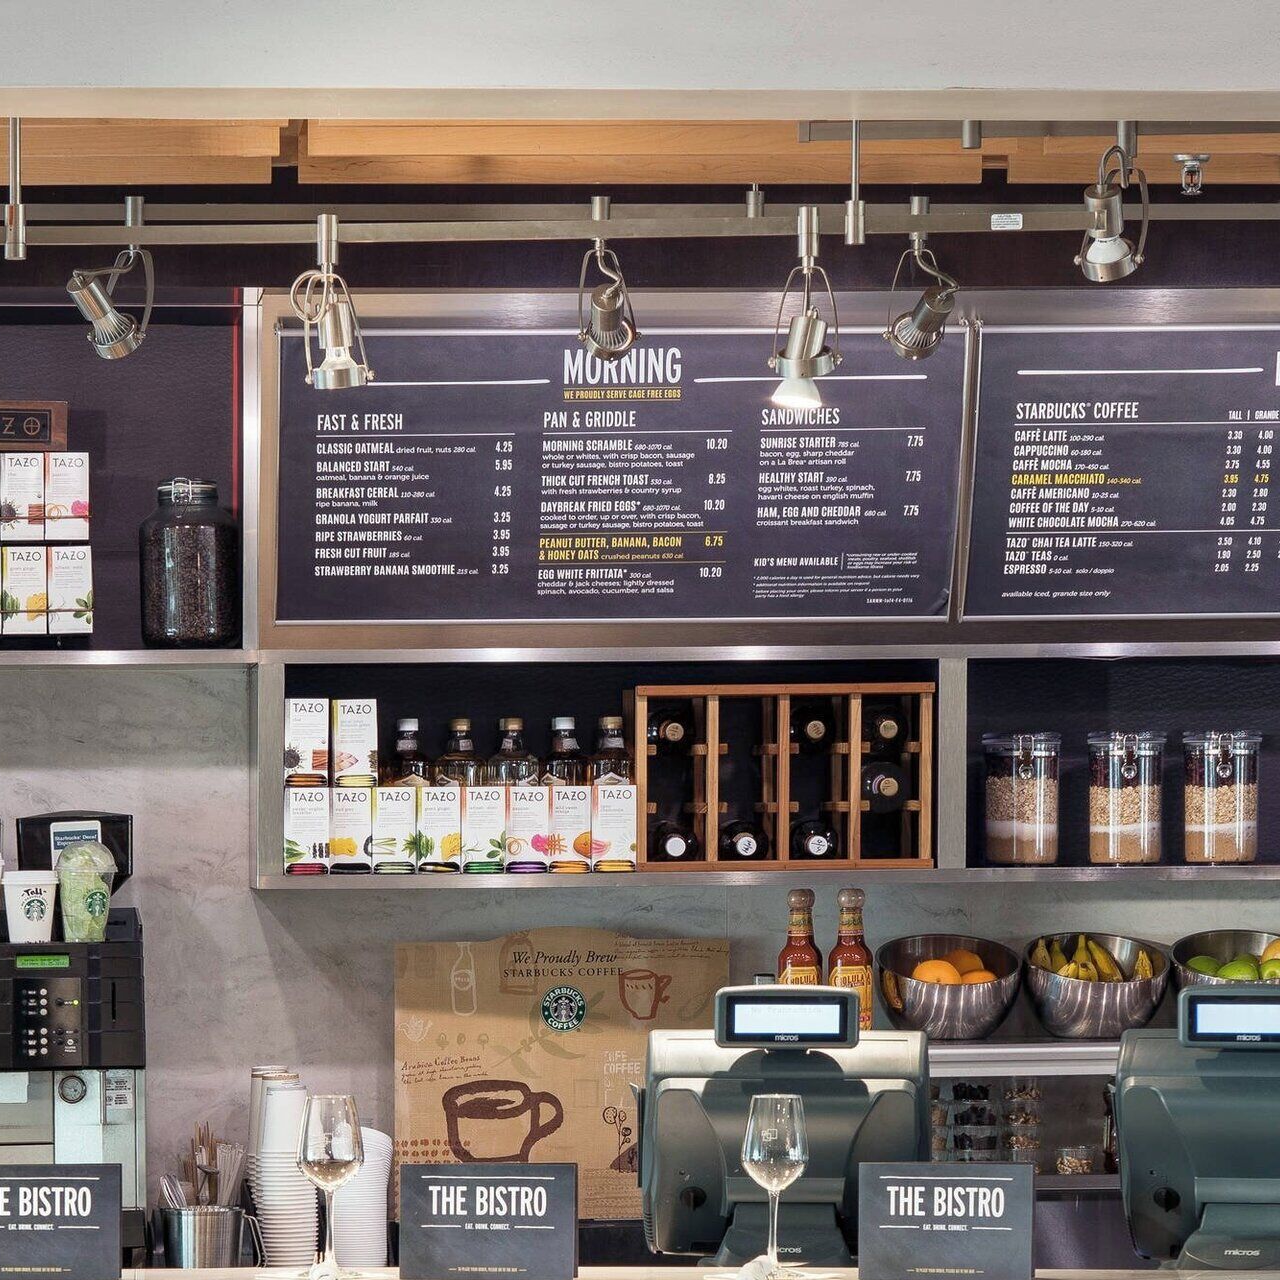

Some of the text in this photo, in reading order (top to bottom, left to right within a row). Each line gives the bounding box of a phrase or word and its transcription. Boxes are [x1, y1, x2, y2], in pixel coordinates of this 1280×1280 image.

[564, 348, 681, 384] MORNING
[564, 390, 680, 399] WE PROUDLY SERVE CAGE FREE EGGS
[1094, 402, 1139, 418] COFFEE
[1229, 411, 1242, 420] TALL
[1255, 410, 1279, 419] GRANDE
[317, 414, 403, 430] FAST & FRESH
[544, 411, 636, 428] PAN & GRIDDLE
[762, 408, 840, 425] SANDWICHES
[317, 441, 513, 454] CLASSIC OATMEAL 4.25
[761, 436, 923, 449] SUNRISE STARTER 7.75
[8, 458, 39, 467] TAZO
[1012, 474, 1052, 485] CARAMEL
[1055, 474, 1104, 484] MACCHIATO
[1224, 475, 1238, 483] 3.95
[1254, 474, 1269, 483] 4.75
[10, 552, 41, 561] TAZO
[754, 558, 774, 567] KID'S
[776, 557, 797, 566] MENU
[800, 557, 838, 566] AVAILABLE
[293, 703, 324, 713] TAZO
[340, 704, 371, 714] TAZO
[336, 793, 367, 802] TAZO
[425, 792, 456, 801] TAZO
[513, 792, 544, 801] TAZO
[601, 790, 632, 799] TAZO
[513, 950, 618, 966] We Proudly Brew
[504, 968, 624, 977] STARBUCKS COFFEE
[543, 987, 584, 1007] STARBUCKS
[547, 1018, 579, 1030] COFFEE
[19, 1187, 91, 1217] BISTRO
[429, 1186, 546, 1216] THE BISTRO
[887, 1186, 1004, 1217] THE BISTRO
